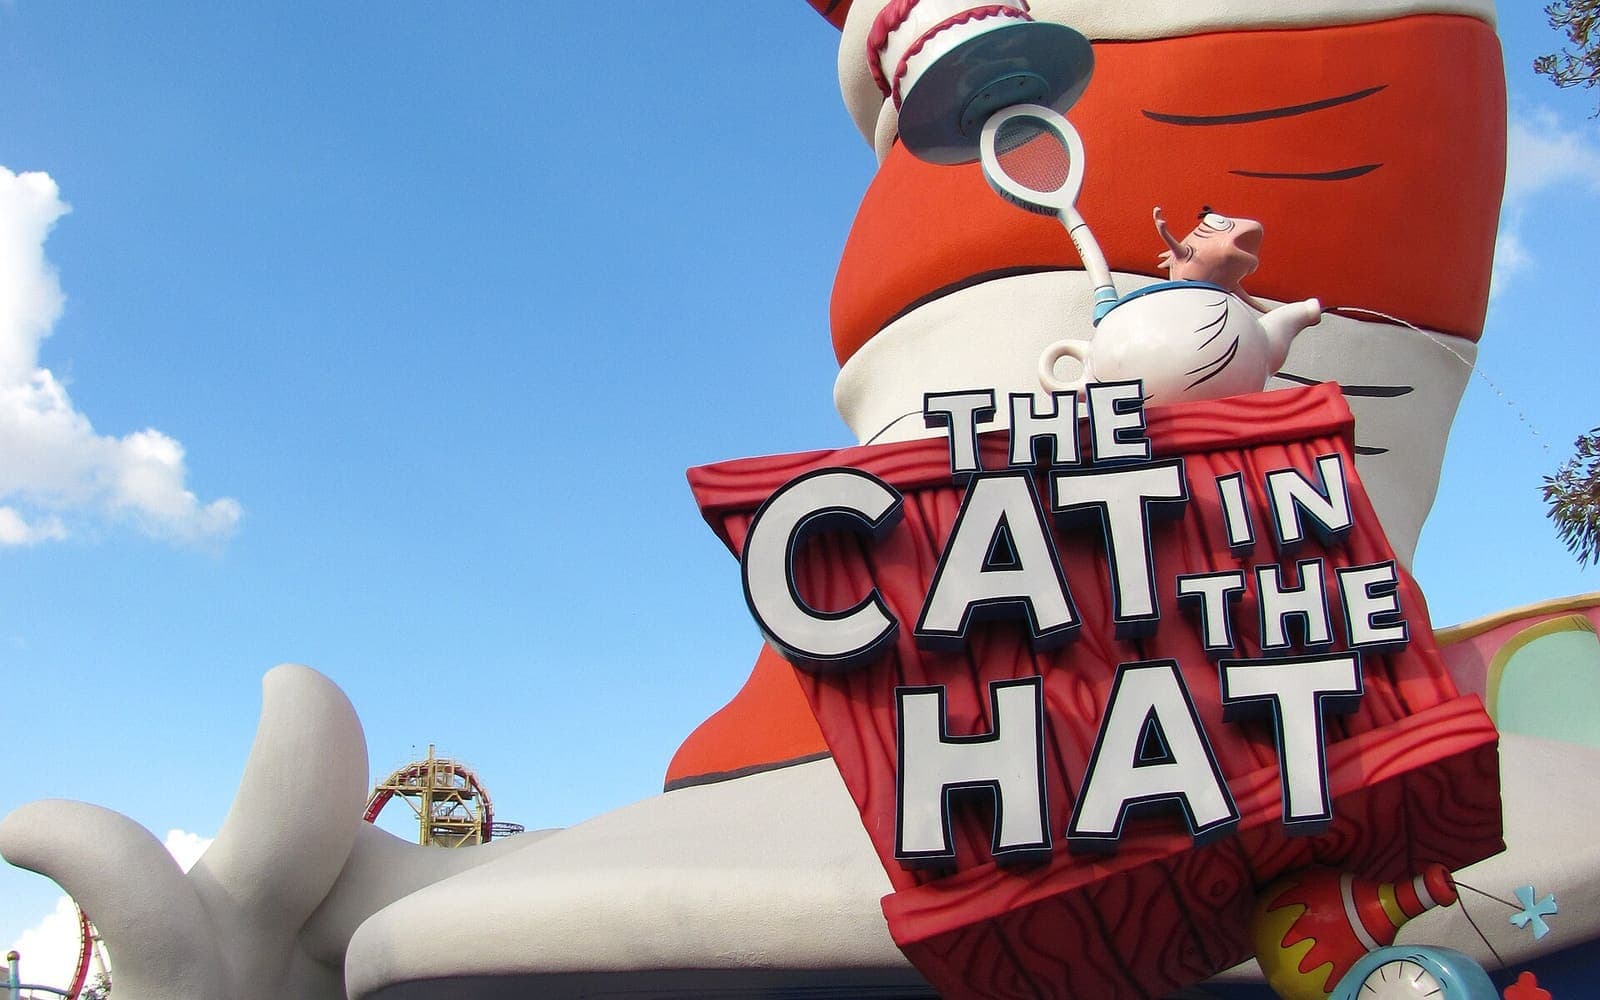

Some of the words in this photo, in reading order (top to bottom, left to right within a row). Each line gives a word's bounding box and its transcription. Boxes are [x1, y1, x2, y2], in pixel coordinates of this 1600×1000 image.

[924, 380, 1151, 474] THE
[1215, 454, 1353, 548] IN
[742, 459, 1188, 662] CAT
[1178, 557, 1409, 650] THE
[895, 651, 1364, 860] HAT
